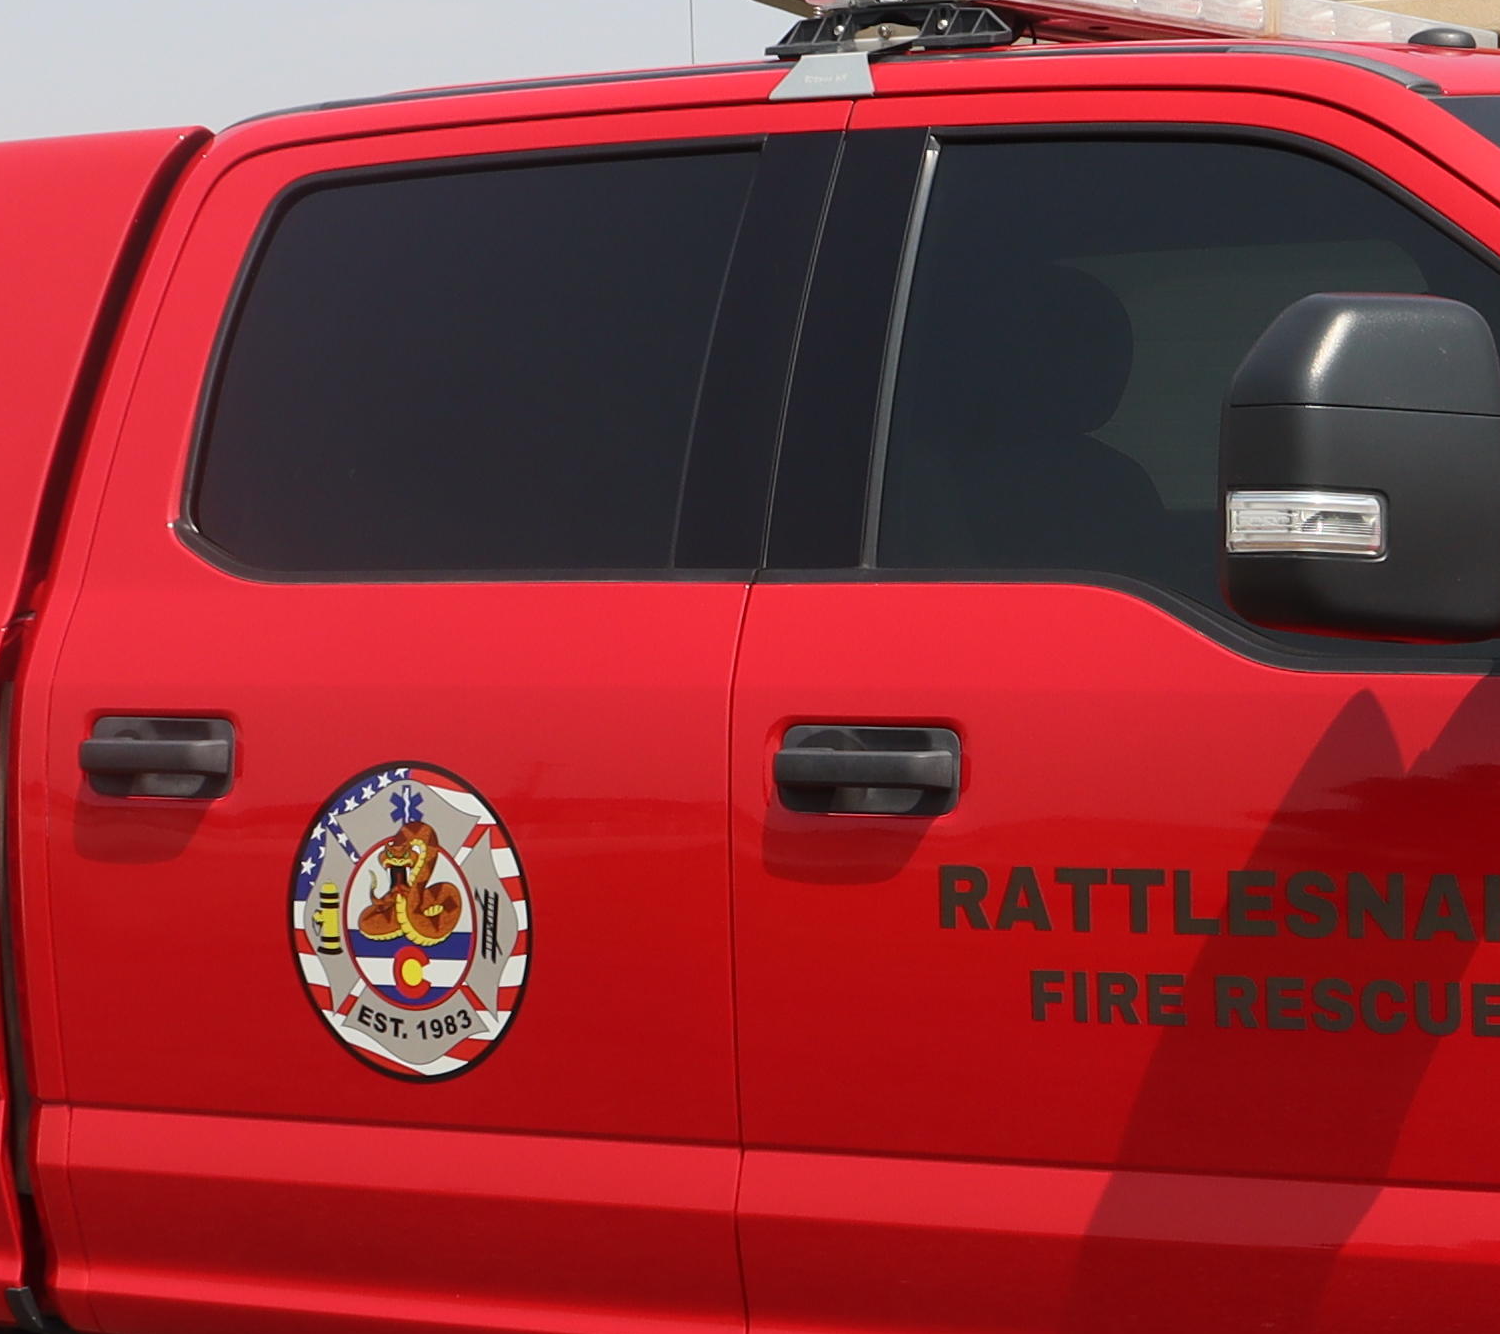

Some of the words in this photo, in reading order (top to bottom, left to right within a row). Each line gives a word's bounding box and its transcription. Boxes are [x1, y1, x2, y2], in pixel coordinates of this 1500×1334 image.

[1030, 969, 1187, 1026] FIRE
[357, 1004, 407, 1039] EST.
[416, 1008, 472, 1041] 1983
